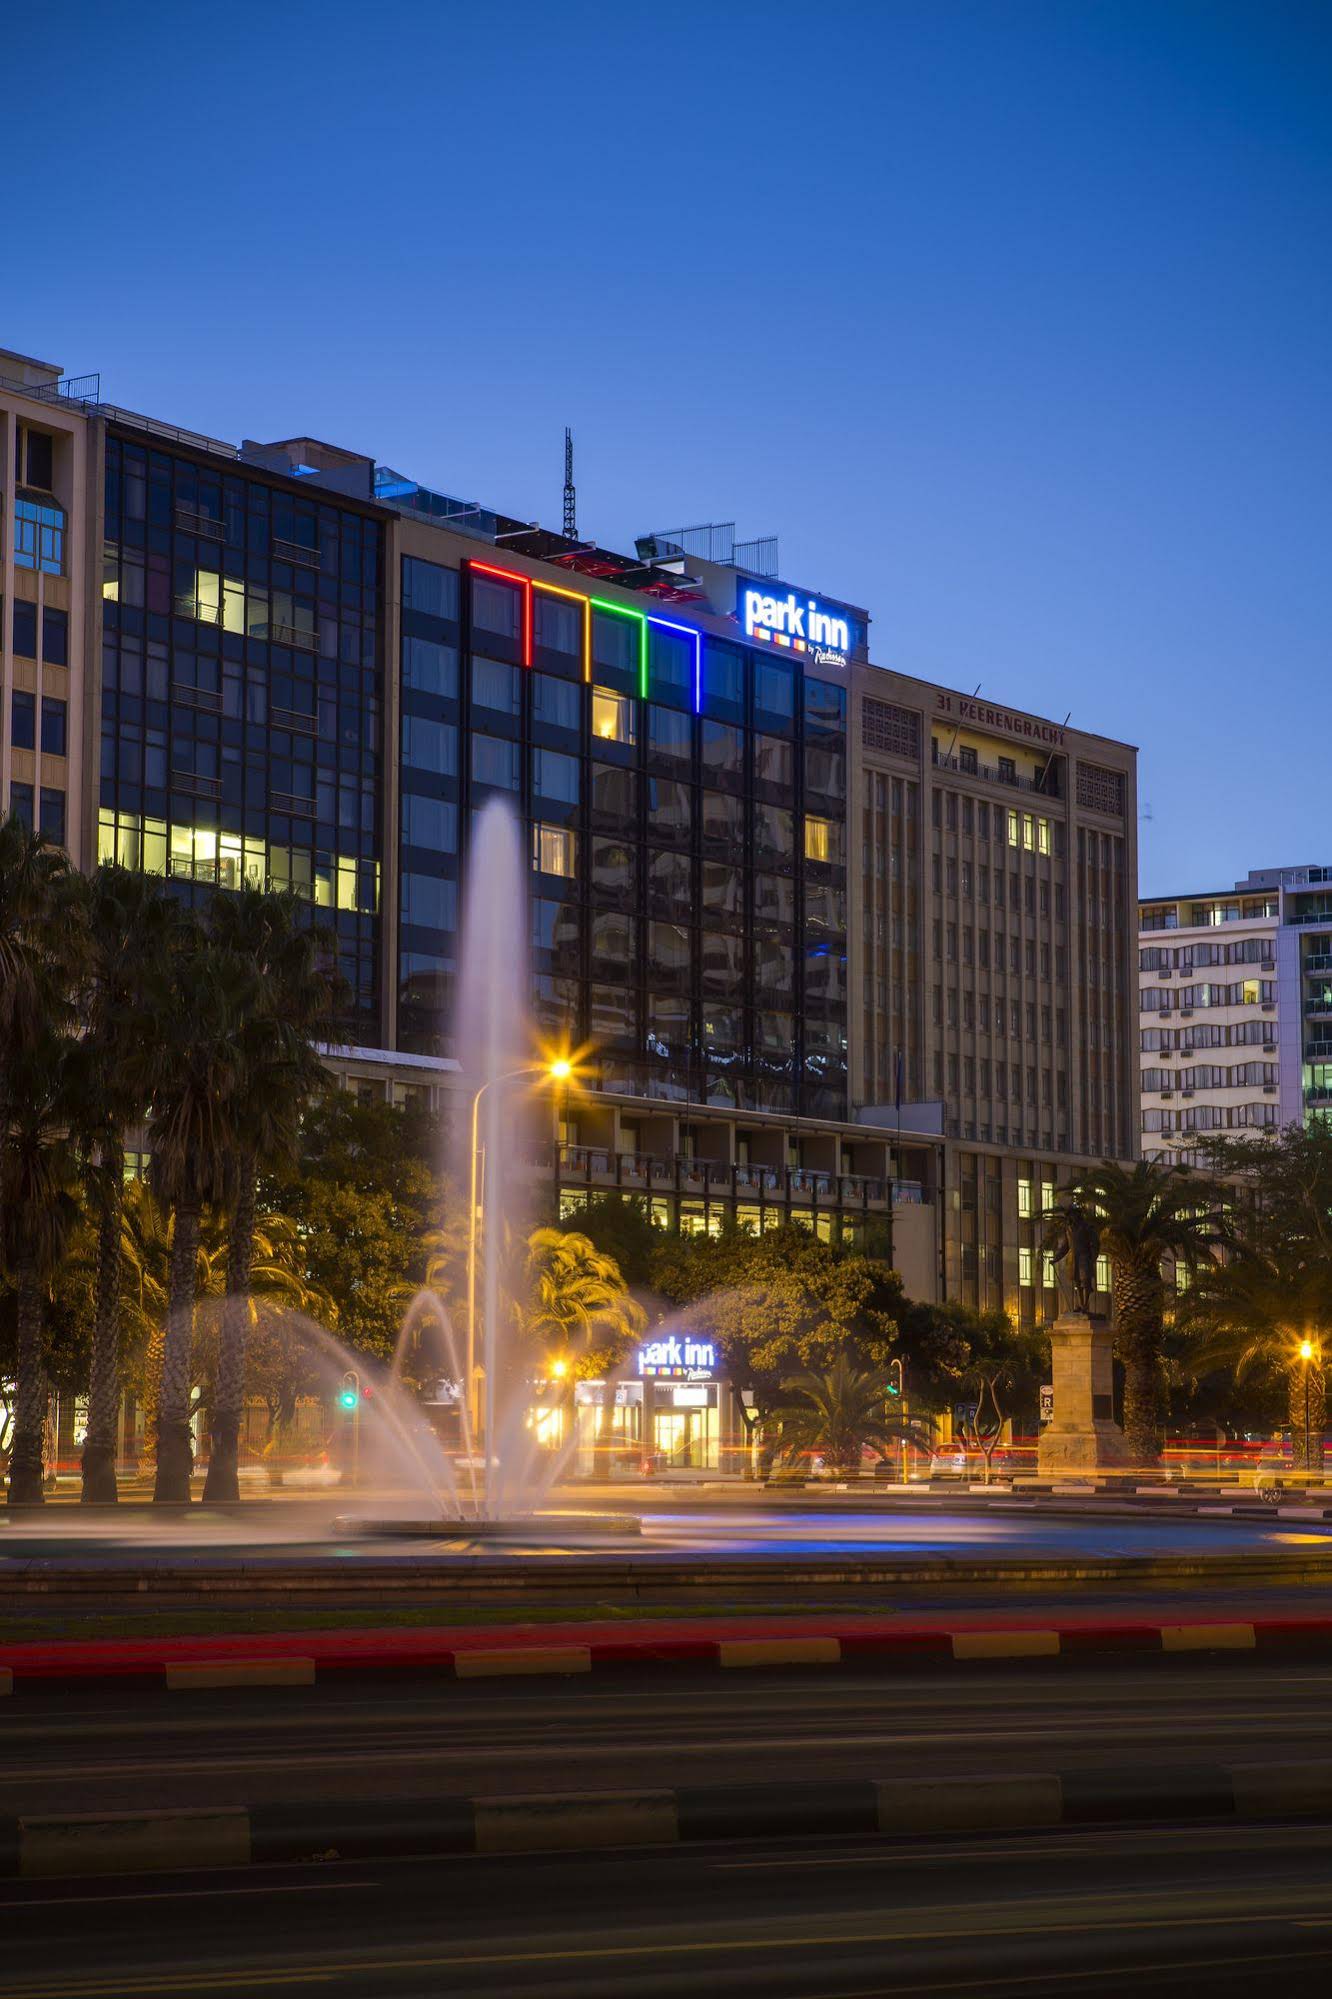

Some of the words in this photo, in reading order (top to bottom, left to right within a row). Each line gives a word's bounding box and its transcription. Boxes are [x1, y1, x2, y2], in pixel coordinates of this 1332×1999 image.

[745, 590, 805, 637] park
[808, 600, 848, 651] inn
[936, 694, 951, 712] 31
[960, 700, 1066, 746] HEERENGRACHT
[638, 1336, 682, 1375] park
[684, 1336, 715, 1367] inn
[1044, 1397, 1051, 1407] R
